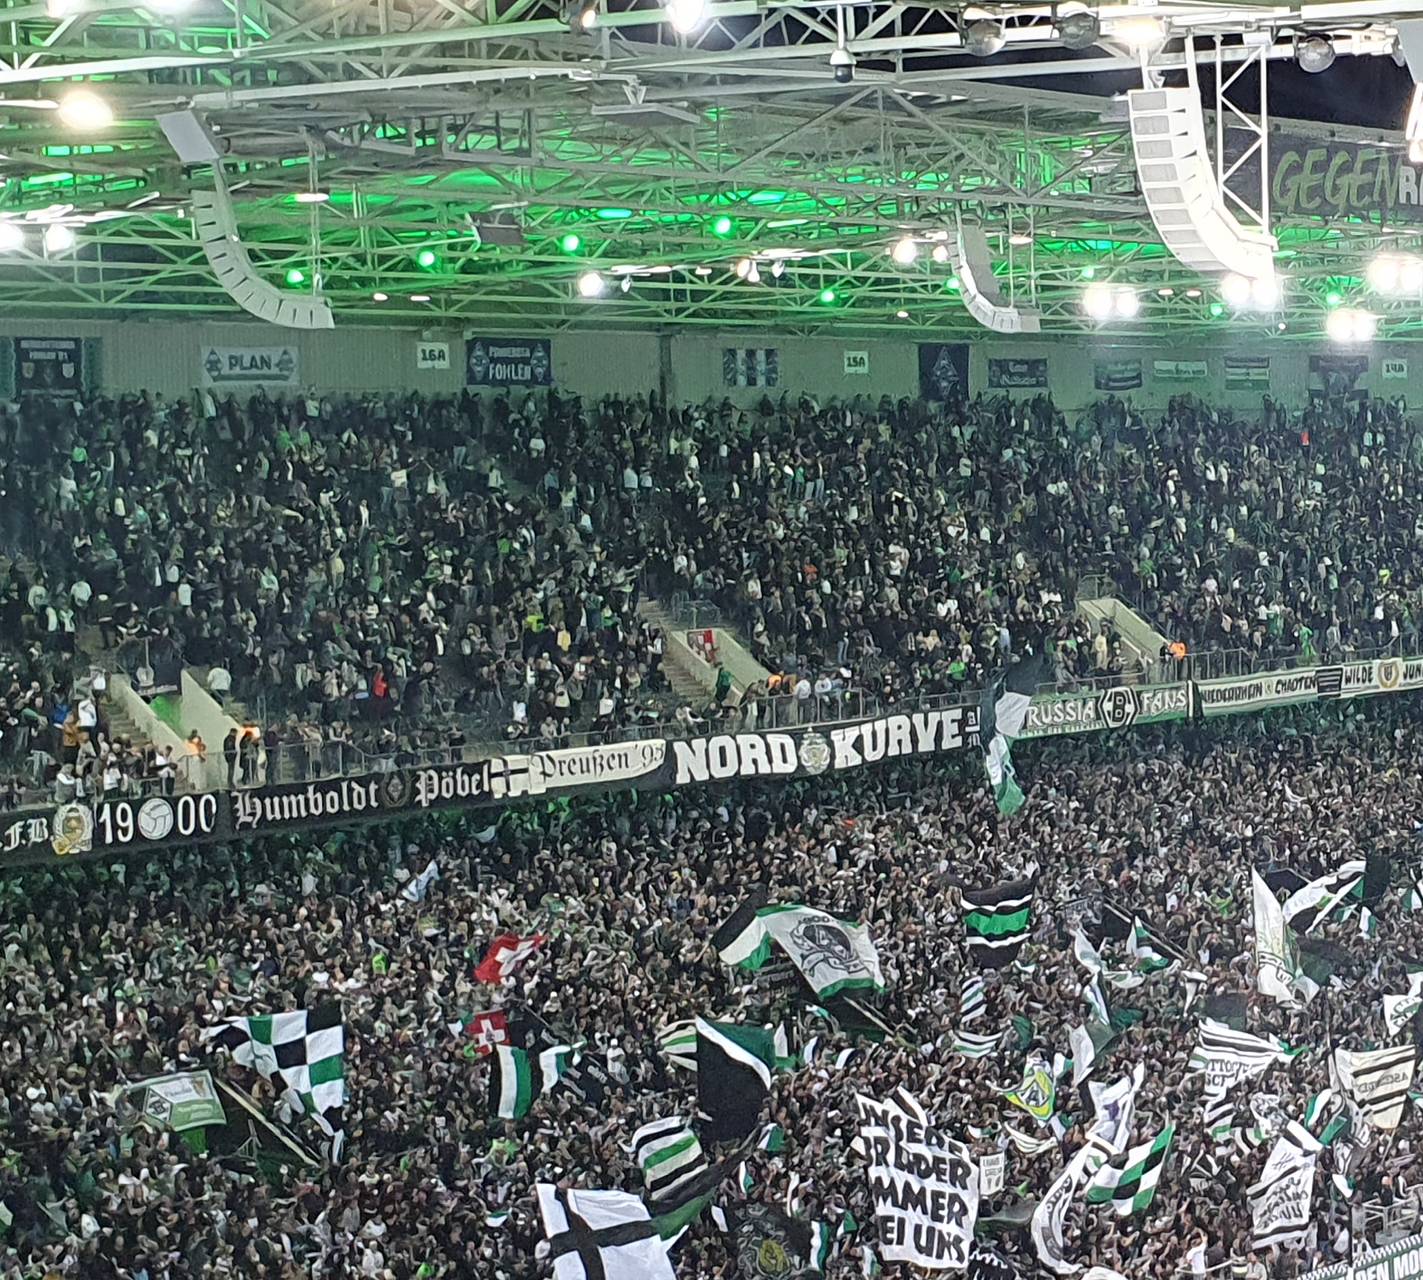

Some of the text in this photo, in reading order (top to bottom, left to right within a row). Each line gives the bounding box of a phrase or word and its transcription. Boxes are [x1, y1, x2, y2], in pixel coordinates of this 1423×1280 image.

[1272, 147, 1400, 215] GEGEN
[228, 354, 273, 371] PLAN
[421, 348, 446, 362] 16A
[845, 356, 867, 368] 15A
[1344, 665, 1373, 685] WILDE
[1025, 700, 1097, 727] RUSSIA
[1139, 689, 1188, 715] FANS
[671, 732, 798, 785] NORD
[830, 708, 963, 769] KURVE
[531, 749, 629, 783] Preußen
[231, 763, 490, 831] Humboldt Pöbel
[871, 1175, 969, 1229] MMER
[878, 1214, 967, 1264] EI UNS
